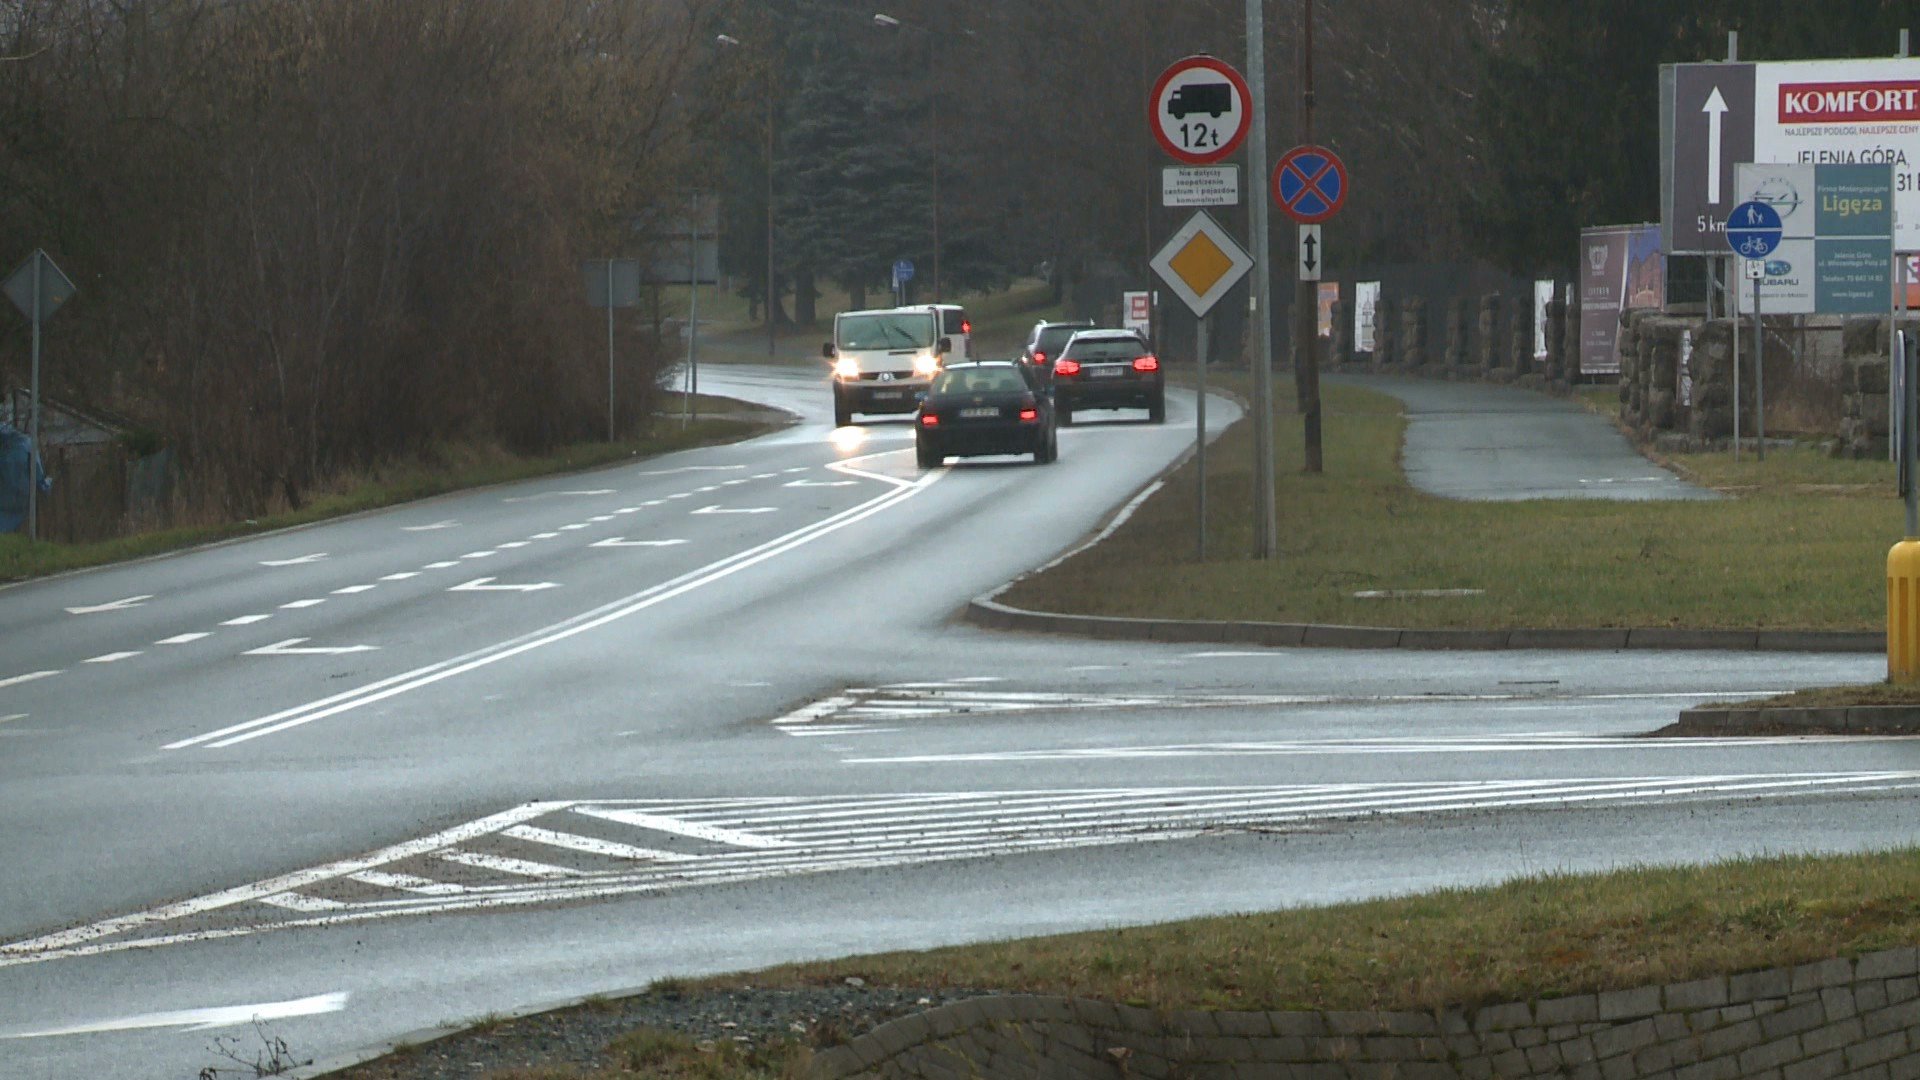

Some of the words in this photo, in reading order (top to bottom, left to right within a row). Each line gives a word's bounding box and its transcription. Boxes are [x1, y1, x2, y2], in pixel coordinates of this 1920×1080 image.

[1785, 89, 1918, 114] KOMFORT
[1785, 127, 1822, 136] NAJLEPSZE
[1859, 125, 1897, 135] NAJLEPSZE
[1899, 124, 1919, 134] CENY
[1194, 169, 1221, 177] dotyczy
[1177, 179, 1224, 187] zaopatrzenia
[1201, 186, 1235, 195] pojazdów
[1177, 196, 1224, 204] komunalnych
[1823, 194, 1883, 217] Ligęza
[1697, 215, 1706, 232] 5
[1709, 214, 1727, 232] km
[1760, 278, 1799, 286] UBARU
